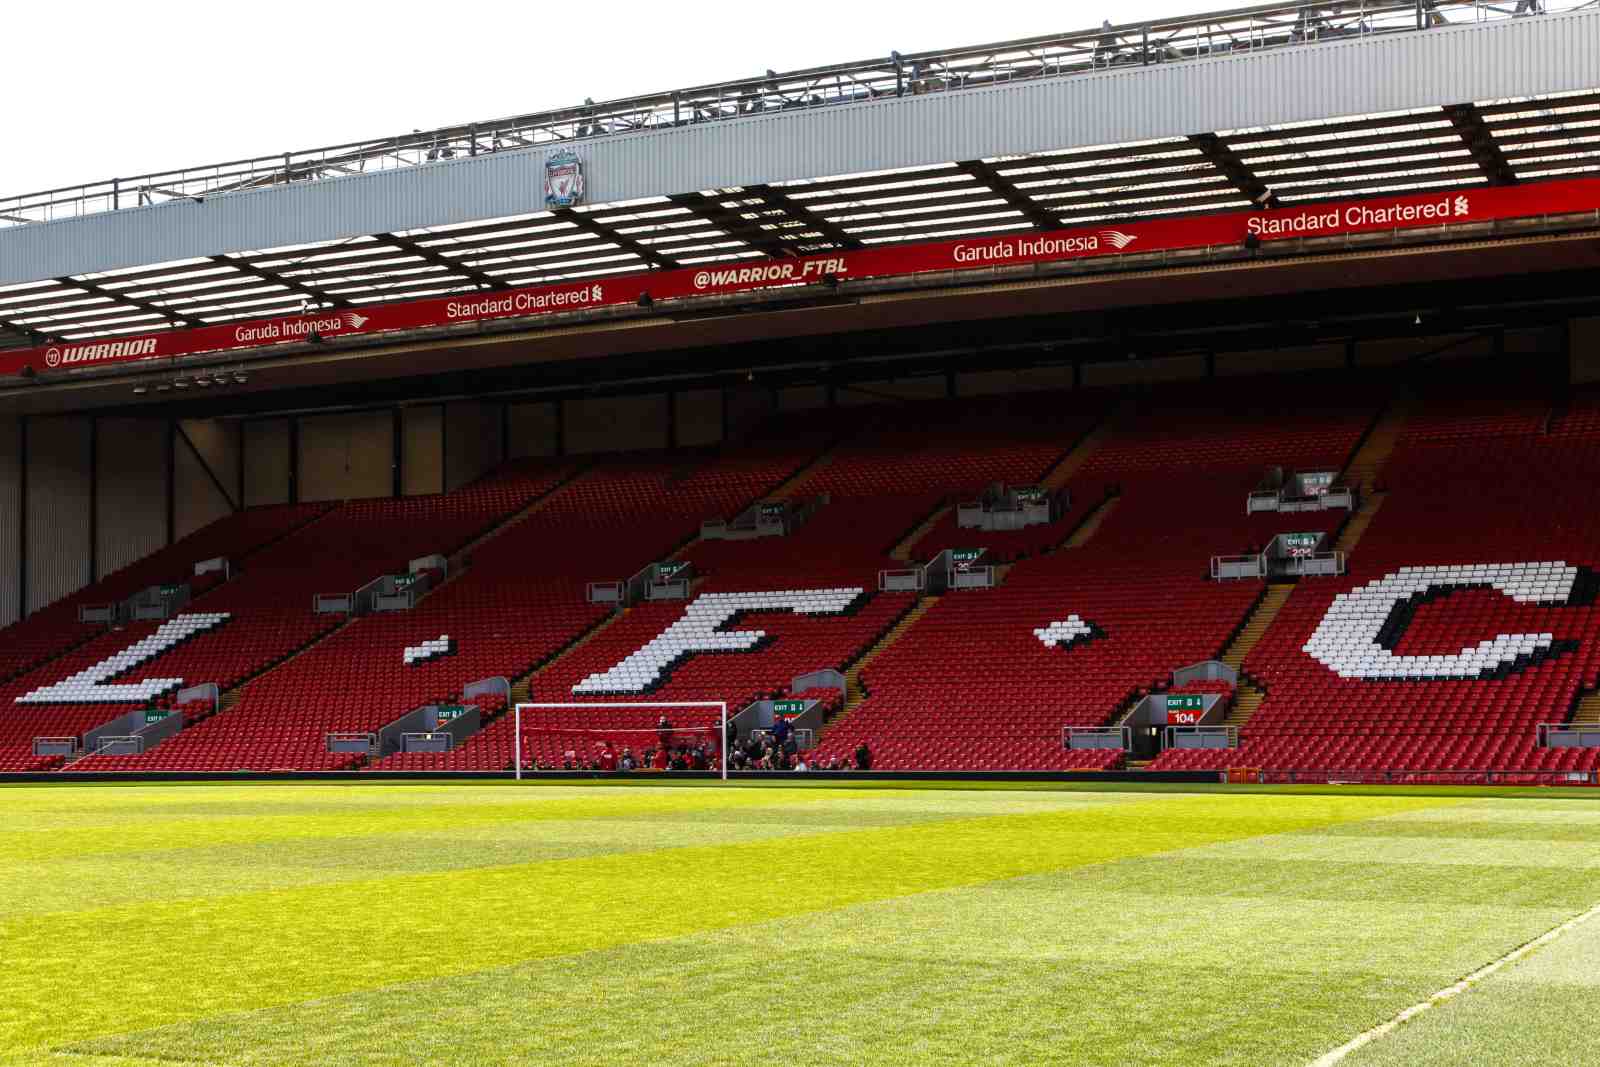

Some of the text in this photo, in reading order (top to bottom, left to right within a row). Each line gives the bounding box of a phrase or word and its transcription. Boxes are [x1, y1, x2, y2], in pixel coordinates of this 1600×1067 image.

[1247, 198, 1450, 235] Standard Chartered
[953, 233, 1098, 264] Garuda Indonesia
[693, 258, 848, 289] @WARRIOR_FTBL
[447, 287, 588, 318] Standard Chartered
[235, 318, 341, 342] Garuda Indonesia
[62, 338, 158, 363] WARRIOR
[1174, 713, 1194, 724] 104
